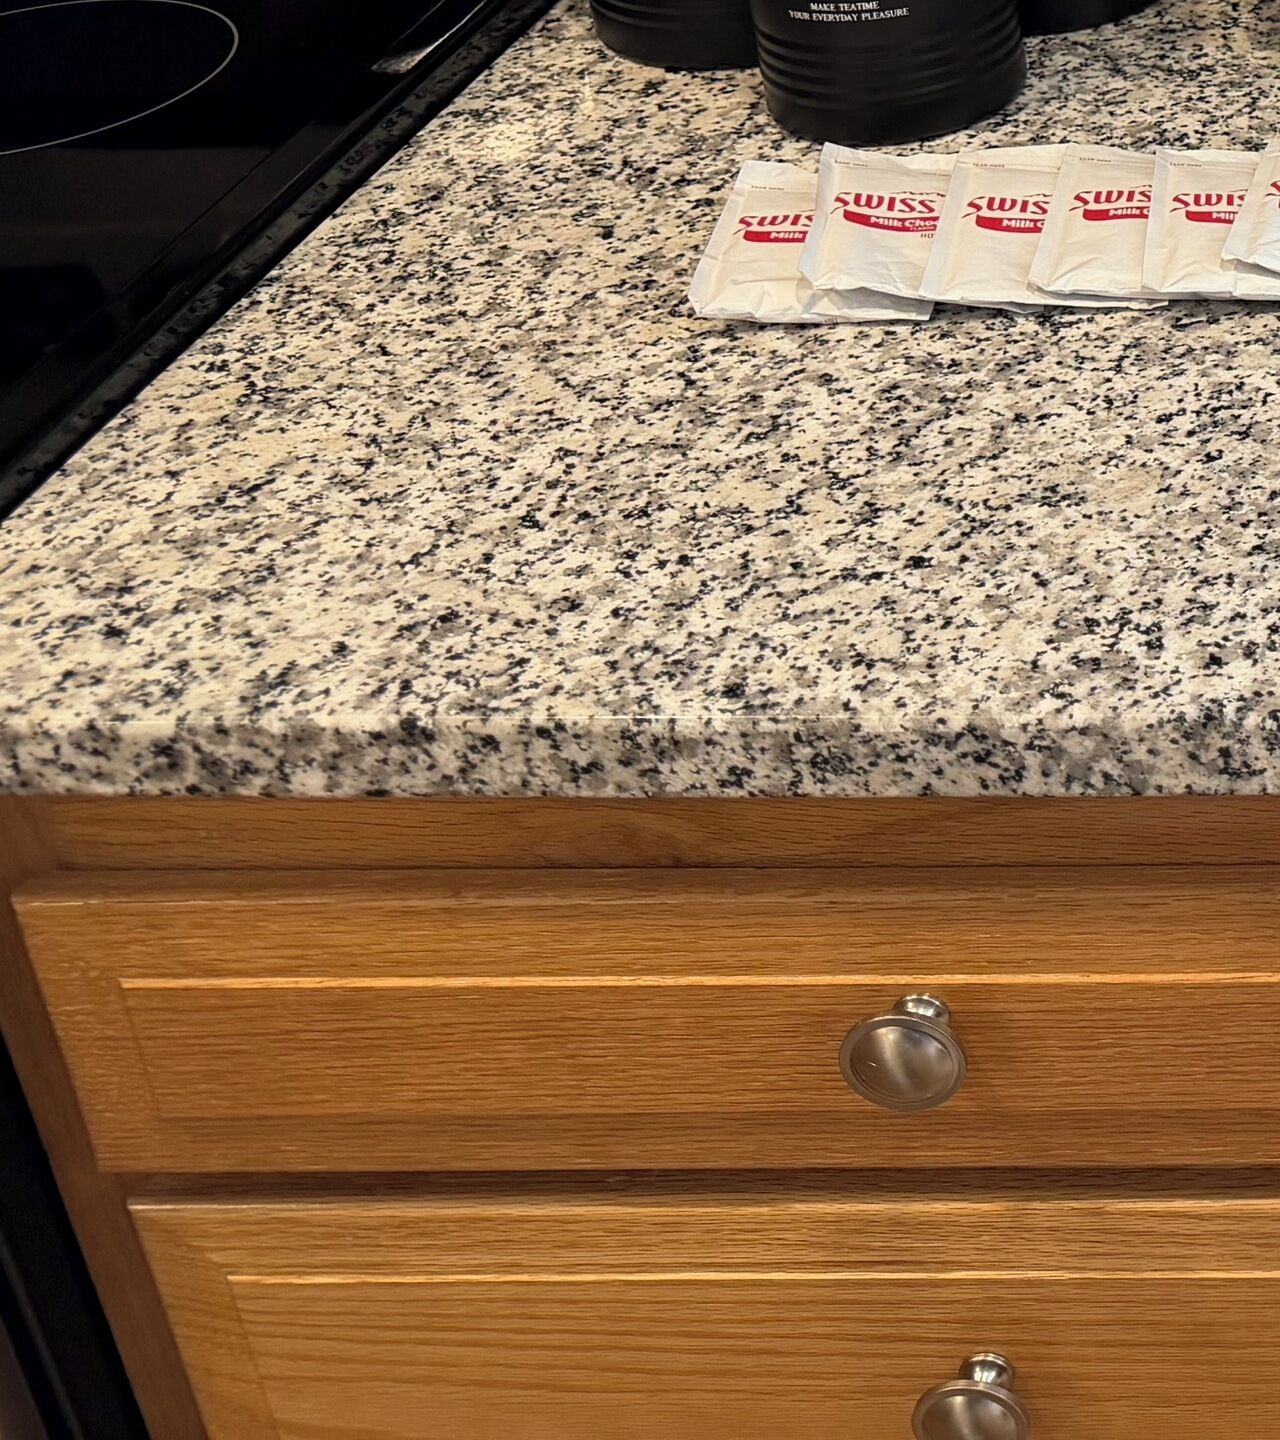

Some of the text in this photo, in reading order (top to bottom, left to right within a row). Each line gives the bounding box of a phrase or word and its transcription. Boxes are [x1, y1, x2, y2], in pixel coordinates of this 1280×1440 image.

[809, 1, 880, 12] MAKE TEATIME
[789, 8, 909, 22] YOUR EVERYDAY PLEASURE
[830, 191, 938, 215] SWISS
[1108, 208, 1139, 216] Milk
[870, 216, 903, 227] Milk
[1002, 219, 1035, 228] Milk
[770, 231, 803, 239] Milk
